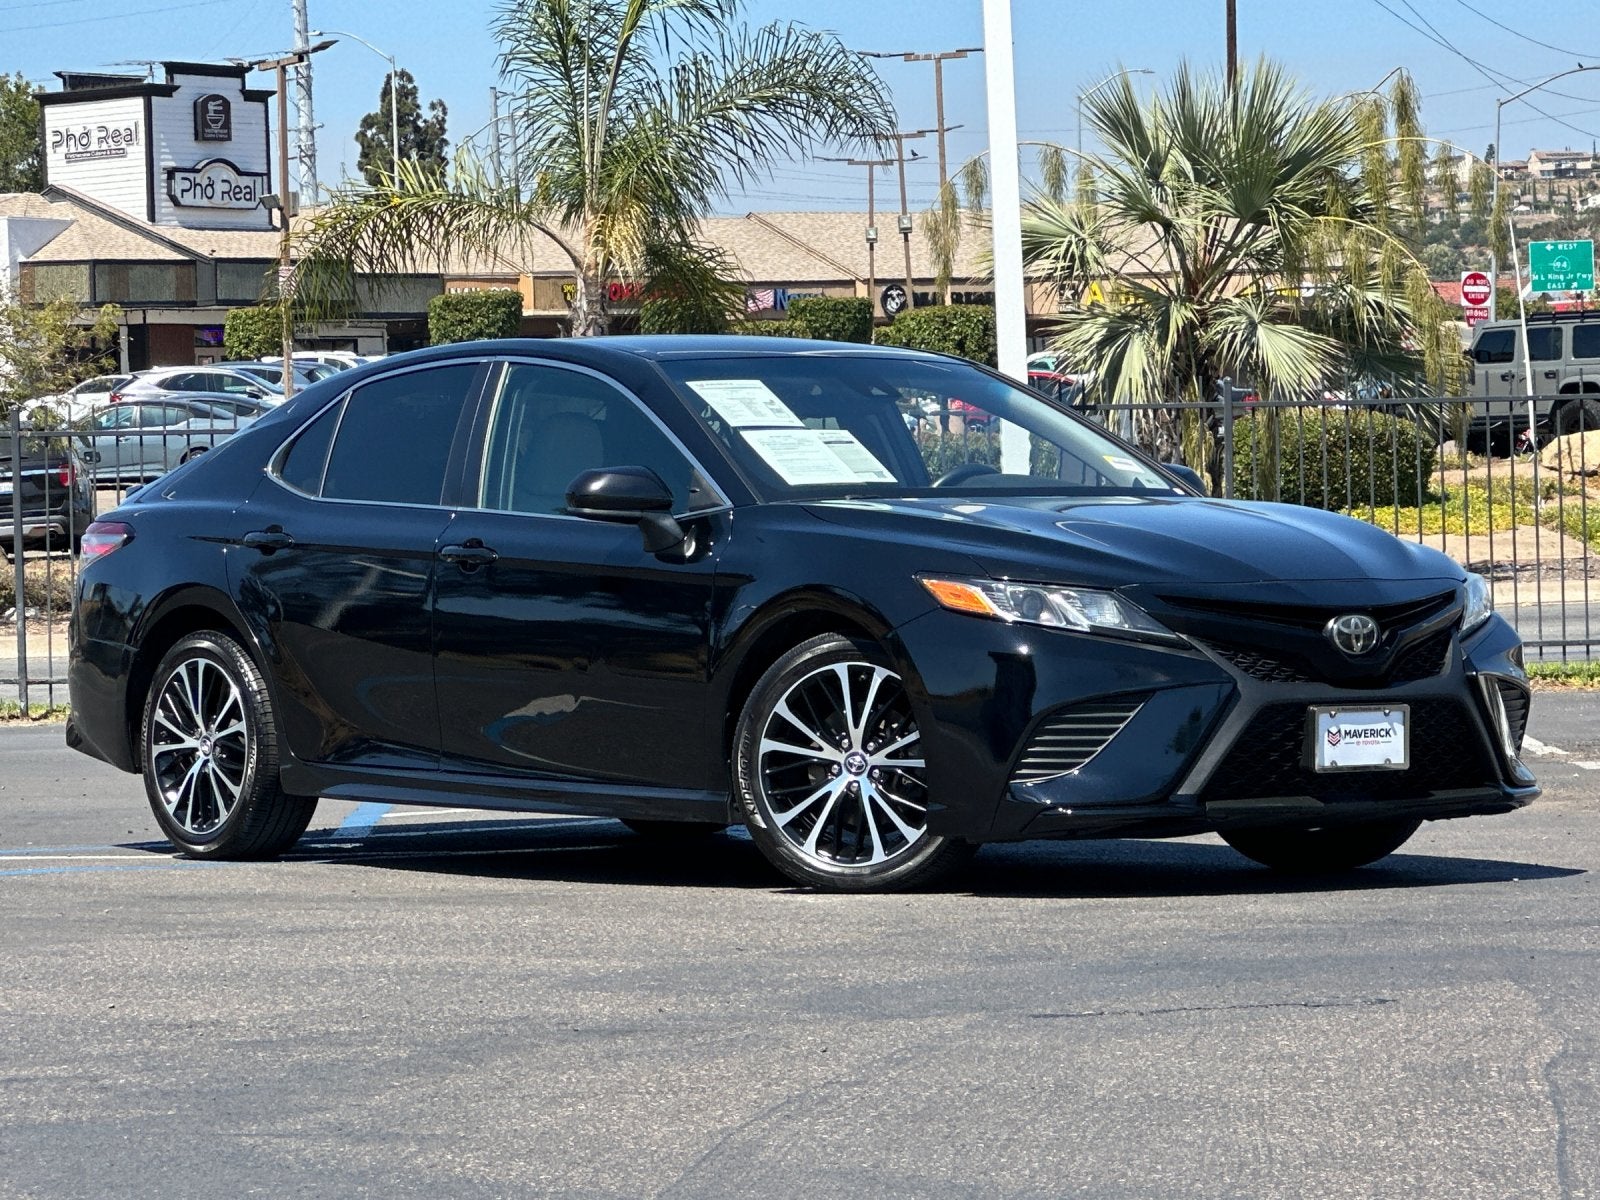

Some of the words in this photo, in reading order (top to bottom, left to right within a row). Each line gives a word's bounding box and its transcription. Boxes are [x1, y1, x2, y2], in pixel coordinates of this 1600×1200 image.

[97, 120, 139, 148] Real
[221, 179, 256, 202] Real
[1547, 273, 1564, 281] King
[1577, 272, 1592, 281] Fwy
[1466, 309, 1488, 317] WRONG
[1344, 728, 1392, 739] MAVERICK
